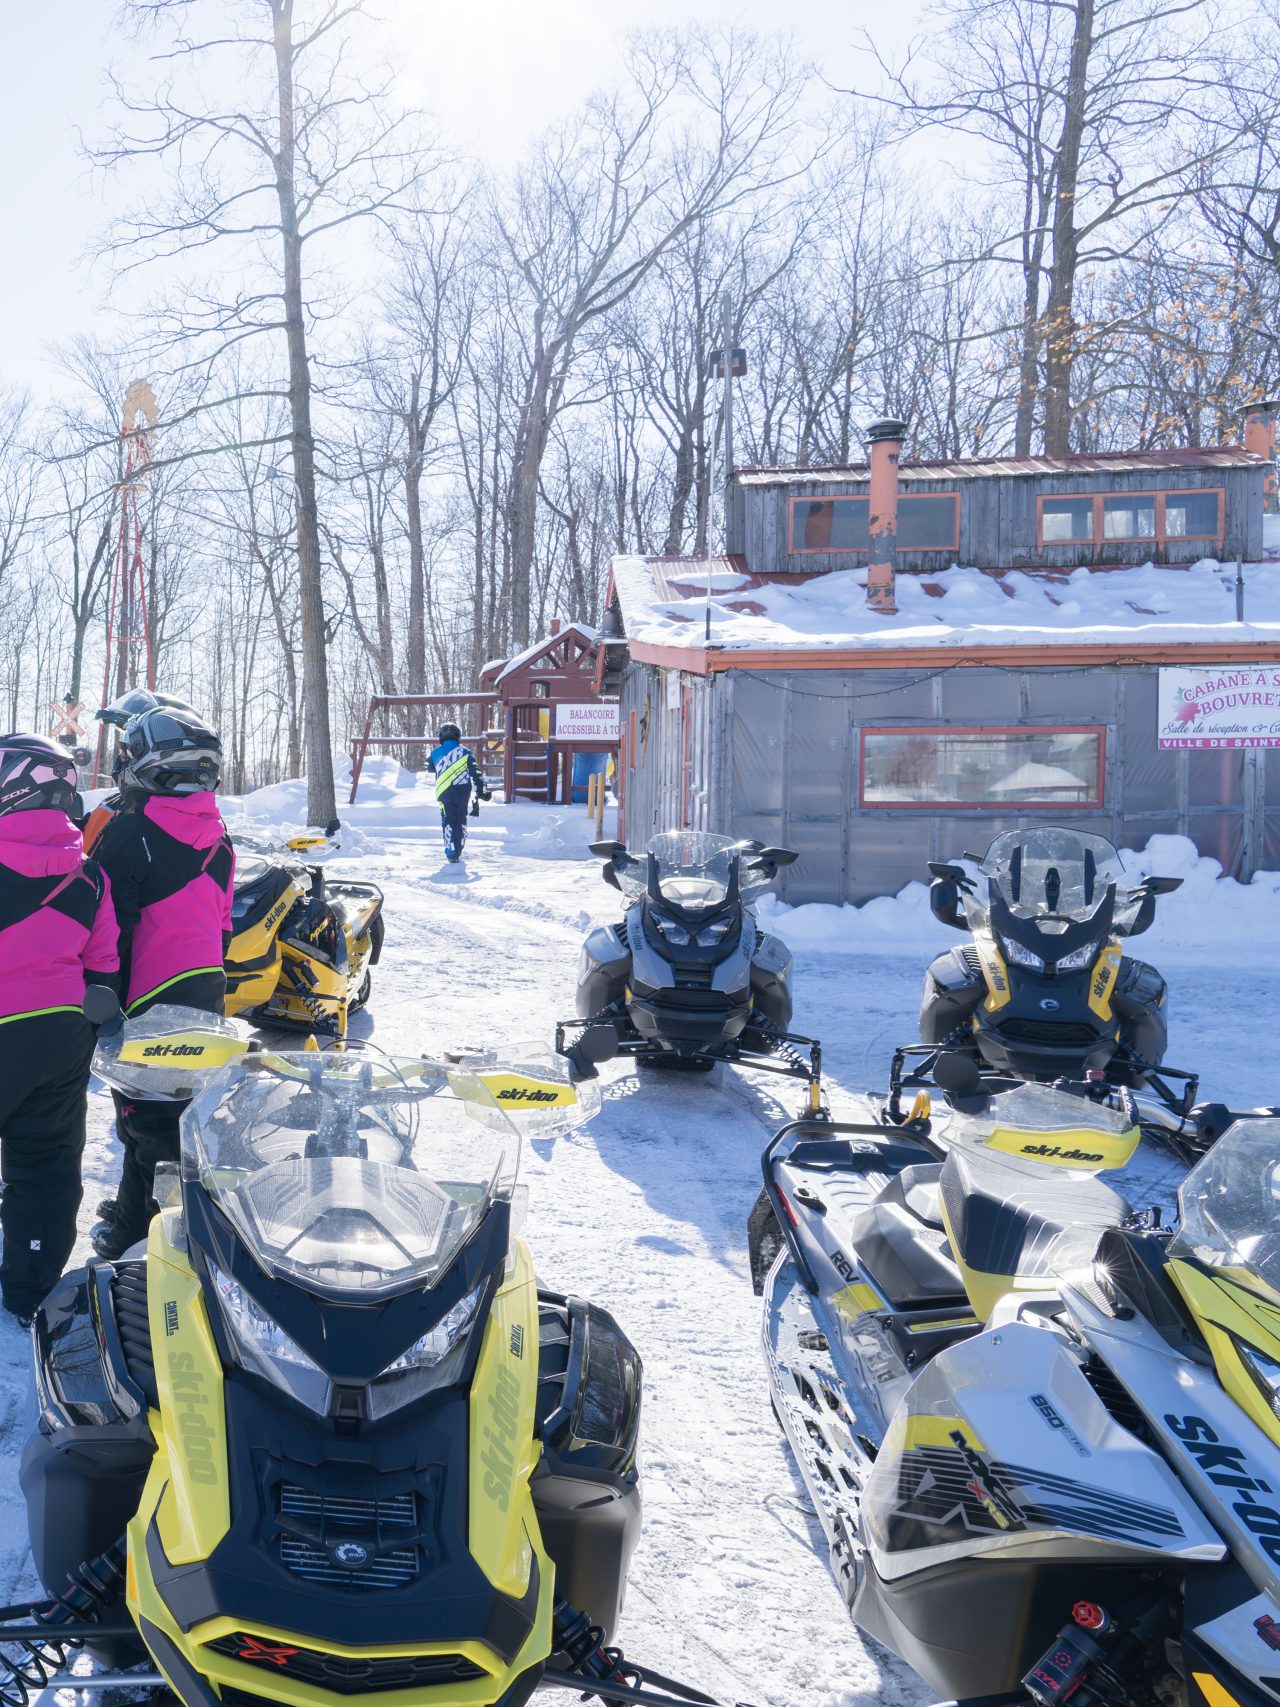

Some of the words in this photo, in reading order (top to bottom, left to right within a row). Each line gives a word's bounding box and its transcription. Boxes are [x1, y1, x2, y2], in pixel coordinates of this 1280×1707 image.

[1183, 673, 1250, 701] CABANE
[1255, 670, 1267, 686] À
[557, 725, 601, 735] ACCESSIBLE
[603, 722, 608, 735] À
[570, 710, 615, 719] BALANCOIRE
[1162, 721, 1189, 736] Salle
[1192, 721, 1205, 734] de
[1208, 723, 1248, 736] réception
[1163, 739, 1204, 748] VILLE
[1210, 739, 1228, 747] DE
[0, 786, 30, 804] ZOX
[264, 901, 287, 932] ski-doo
[986, 961, 1007, 992] ski-doo
[1092, 966, 1112, 998] ski-doo
[142, 1044, 205, 1057] ski-doo
[496, 1088, 559, 1102] ski-doo
[1020, 1144, 1105, 1162] ski-doo
[830, 1250, 860, 1283] REV
[166, 1300, 179, 1331] CONTANT
[510, 1324, 521, 1358] CONTANT
[167, 1351, 218, 1486] ski-doo
[1030, 1394, 1065, 1429] 850
[480, 1363, 521, 1514] ski-doo
